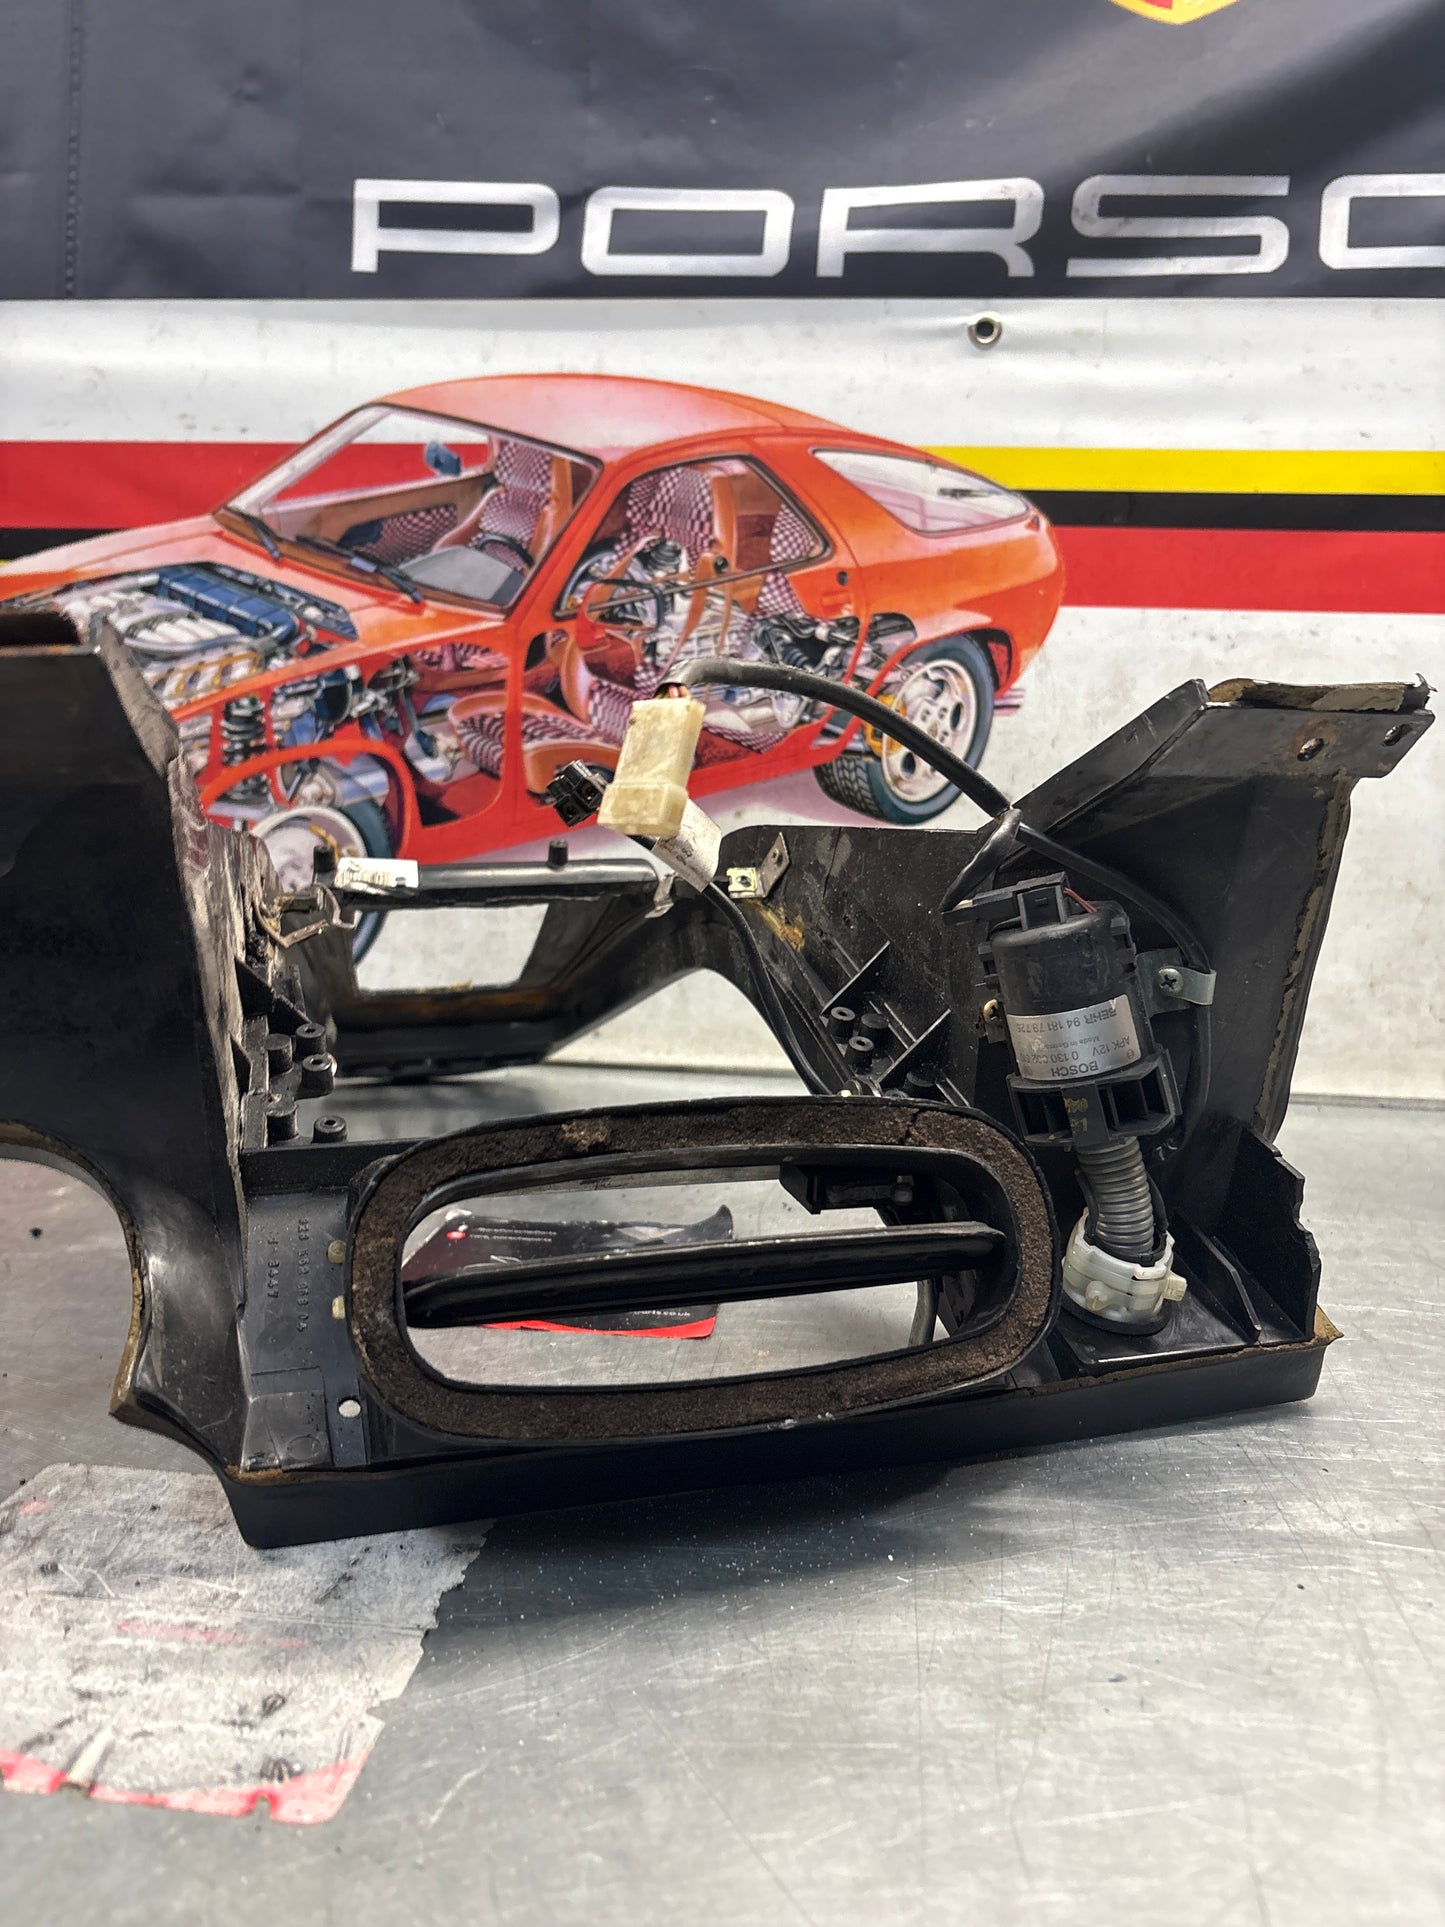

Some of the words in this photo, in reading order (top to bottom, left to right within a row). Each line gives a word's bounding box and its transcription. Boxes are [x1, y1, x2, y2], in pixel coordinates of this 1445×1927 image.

[1083, 1007, 1118, 1025] BEHR
[1046, 1020, 1064, 1031] 181
[1066, 1017, 1081, 1027] 94
[1033, 1023, 1046, 1033] 79
[1079, 1036, 1100, 1047] Made
[1112, 1035, 1130, 1050] APK
[1071, 1051, 1079, 1061] 0
[1092, 1044, 1111, 1057] 12V
[1050, 1052, 1069, 1063] 130
[1051, 1060, 1099, 1077] BOSCH
